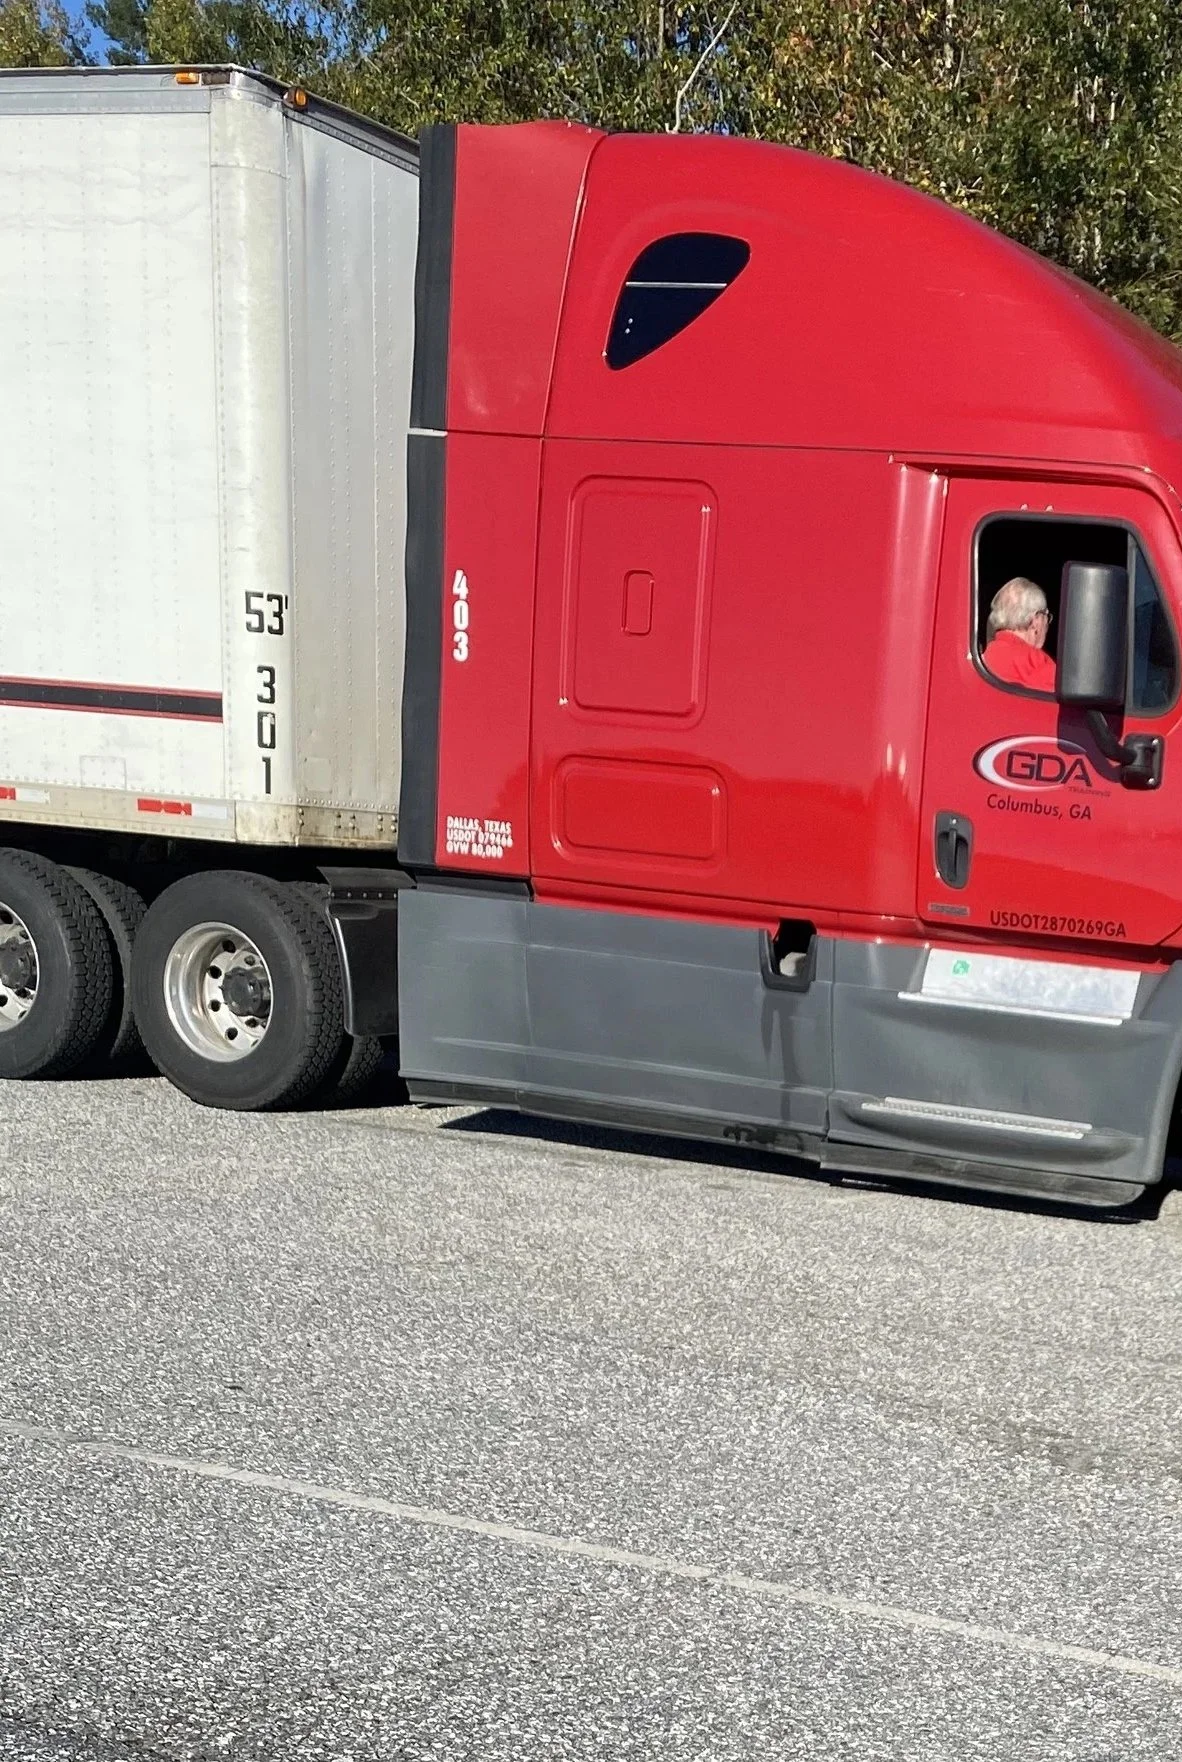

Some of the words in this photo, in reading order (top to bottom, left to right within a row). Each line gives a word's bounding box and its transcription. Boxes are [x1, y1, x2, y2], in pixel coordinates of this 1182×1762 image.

[452, 569, 469, 662] 403
[1006, 750, 1092, 787] GDA
[987, 794, 1063, 819] Columbus,
[1069, 804, 1092, 820] GA
[447, 816, 482, 831] DALLAS,
[484, 820, 512, 834] TEXAS
[447, 828, 476, 843] USDOT
[446, 840, 469, 854] GVW
[471, 843, 503, 859] 80,000
[990, 910, 1126, 937] USDOT2870269GA
